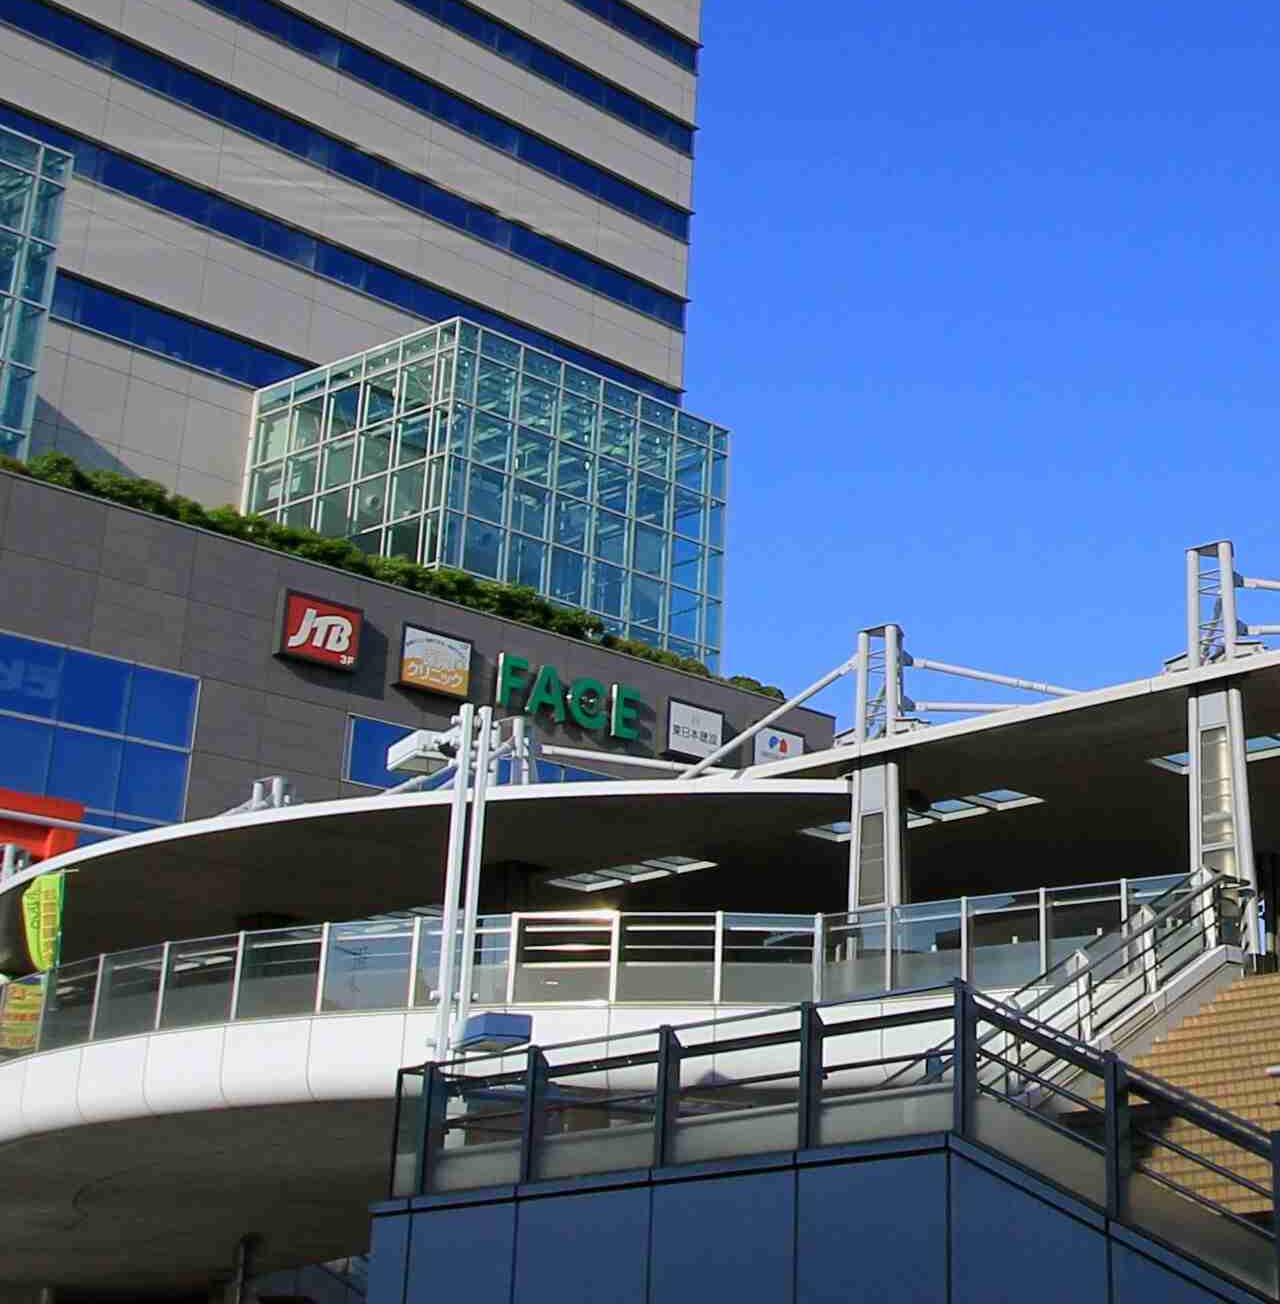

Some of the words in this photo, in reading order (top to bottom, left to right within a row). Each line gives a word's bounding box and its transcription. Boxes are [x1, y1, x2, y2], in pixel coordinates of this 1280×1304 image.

[287, 607, 353, 652] JTB
[339, 654, 355, 666] 3F
[406, 662, 464, 689] クリニック
[496, 652, 640, 741] FACE
